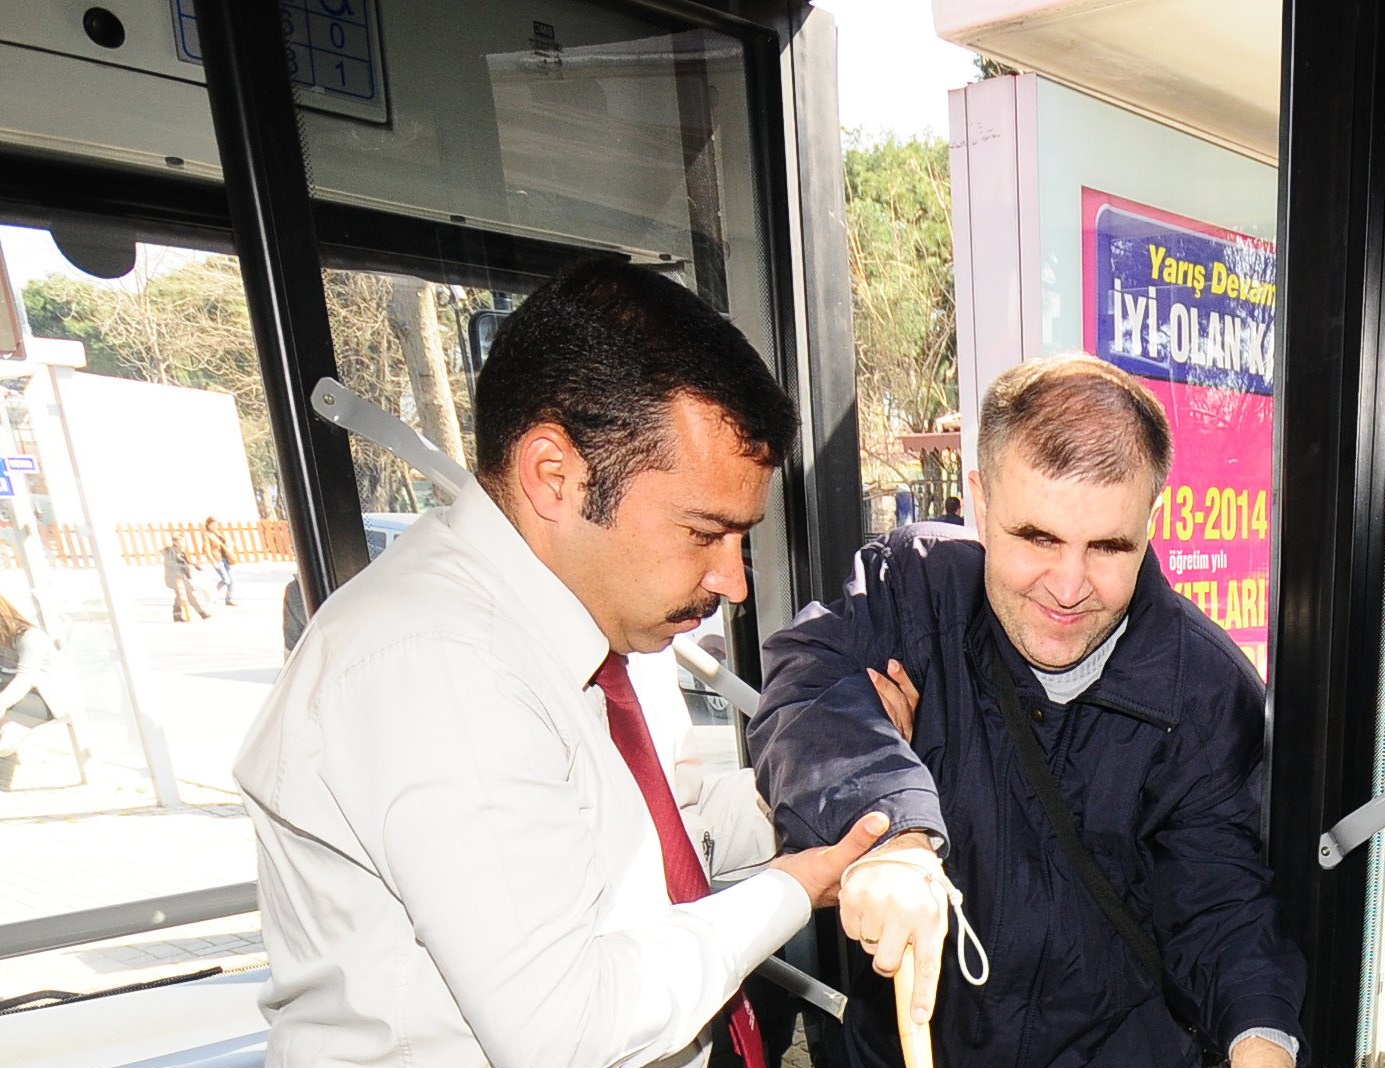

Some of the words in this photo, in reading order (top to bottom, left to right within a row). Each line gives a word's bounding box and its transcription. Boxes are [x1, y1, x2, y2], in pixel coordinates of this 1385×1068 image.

[1149, 244, 1206, 298] Yarış
[1114, 278, 1159, 357] İYİ
[1170, 302, 1242, 372] OLAN
[1148, 485, 1268, 541] 13-2014
[1169, 550, 1209, 574] öğretim
[1211, 549, 1228, 573] yılı
